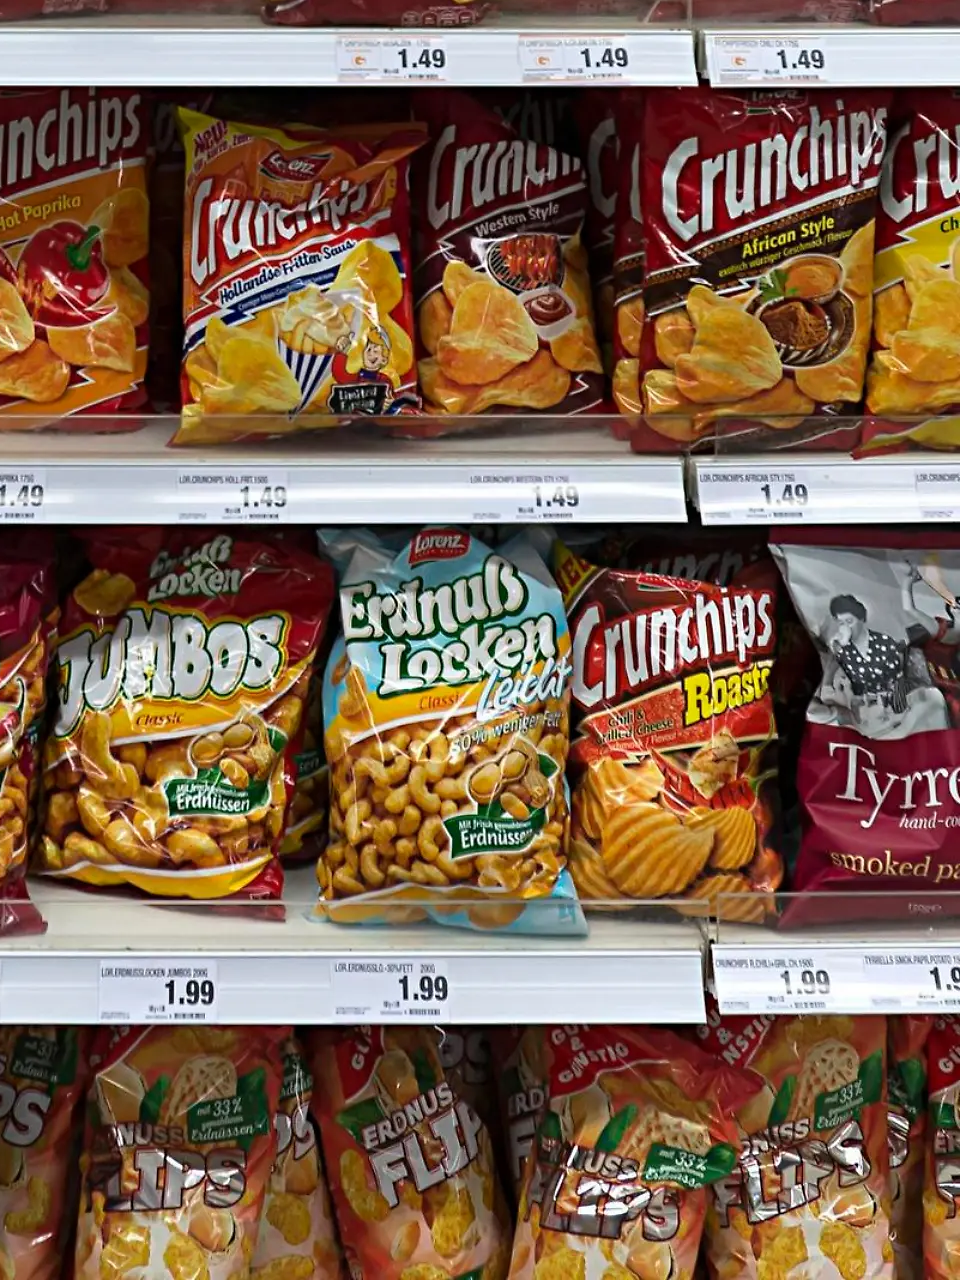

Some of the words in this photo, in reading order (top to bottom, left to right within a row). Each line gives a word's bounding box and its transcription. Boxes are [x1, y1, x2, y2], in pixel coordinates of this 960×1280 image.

[396, 49, 446, 70] 1.49
[579, 48, 629, 69] 1.49
[776, 49, 825, 70] 1.49
[662, 100, 887, 242] Crunchips
[23, 194, 83, 221] Paprika
[475, 215, 527, 238] Western
[529, 201, 561, 222] Style
[188, 179, 368, 289] Crunchips
[741, 230, 797, 259] African
[800, 215, 836, 238] Style
[219, 268, 280, 304] Hollandse
[281, 251, 322, 277] Fritten
[323, 239, 356, 261] Saus
[339, 388, 378, 402] Limited
[240, 486, 288, 508] 1.49
[531, 485, 579, 507] 1.49
[760, 483, 808, 506] 1.49
[415, 534, 464, 554] Lorenz
[147, 567, 243, 602] Locken
[340, 555, 528, 641] Erdnuß
[377, 616, 556, 698] Locken
[570, 588, 773, 708] Crunchips
[54, 607, 284, 738] JUMBOS
[135, 710, 185, 728] Classic
[491, 714, 537, 737] weniger
[635, 719, 674, 734] Cheese
[176, 790, 252, 812] Erdnüssen
[831, 850, 929, 878] smoked
[164, 978, 215, 1006] 1.99
[398, 974, 449, 1002] 1.99
[779, 968, 831, 996] 1.99
[839, 1080, 863, 1102] 33%
[213, 1099, 243, 1117] 33%
[191, 1124, 257, 1141] Erdnüssen
[675, 1152, 708, 1172] 33%
